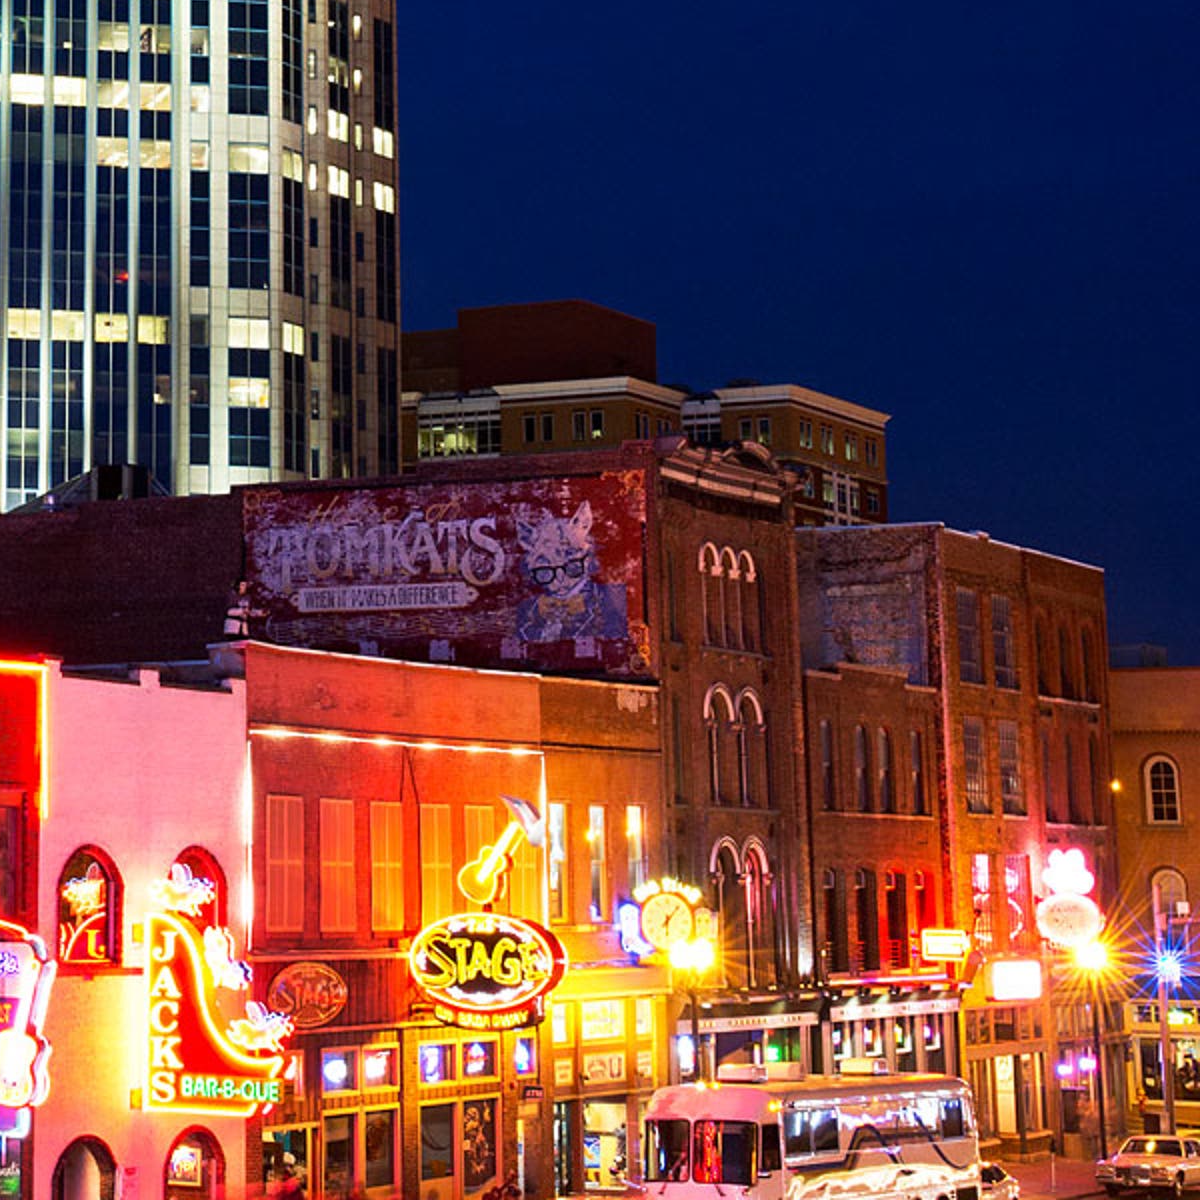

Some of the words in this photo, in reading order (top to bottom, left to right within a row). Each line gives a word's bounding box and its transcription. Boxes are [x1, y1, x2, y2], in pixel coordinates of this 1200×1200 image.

[304, 590, 335, 609] WHEN
[388, 587, 398, 606] A
[398, 584, 458, 605] DIFFERENCE
[419, 928, 549, 990] STAGE
